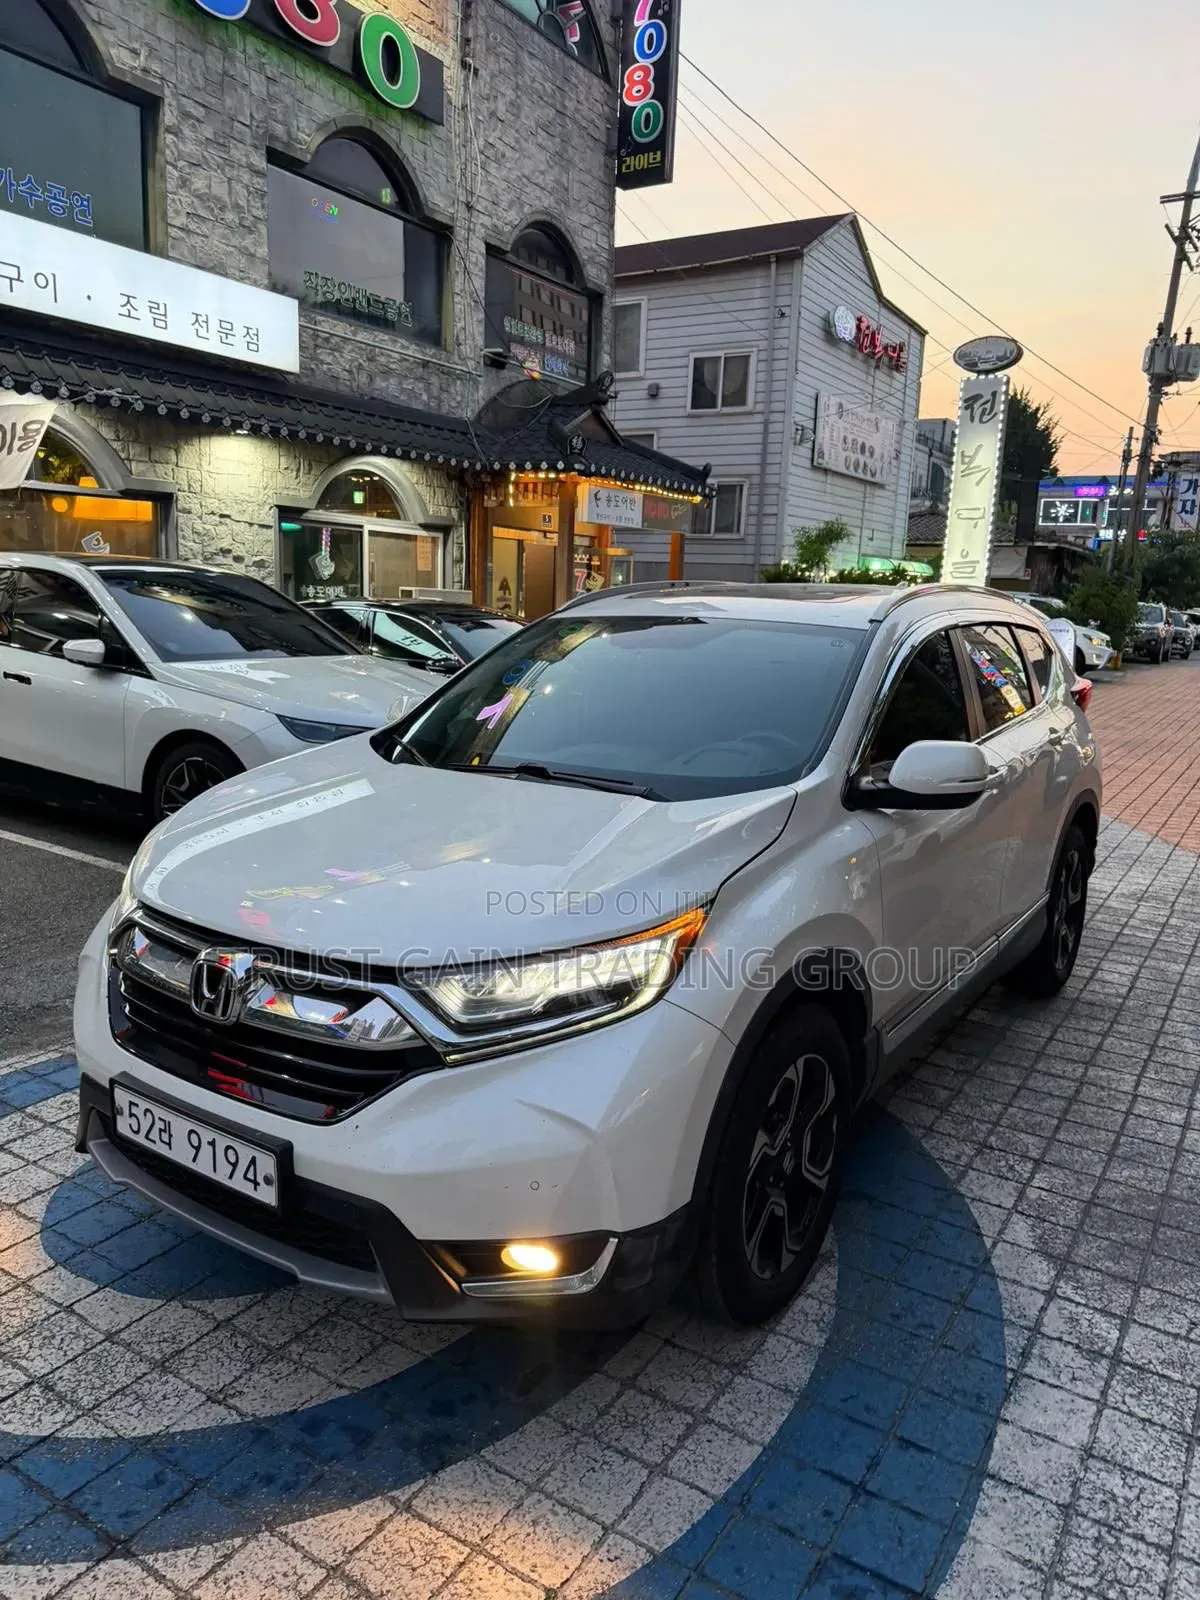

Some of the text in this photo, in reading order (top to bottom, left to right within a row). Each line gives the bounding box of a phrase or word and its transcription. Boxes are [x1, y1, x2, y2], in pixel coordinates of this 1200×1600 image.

[193, 0, 421, 108] 80
[622, 150, 662, 173] 라이브
[118, 292, 169, 331] 조림
[191, 310, 261, 353] 전문점
[127, 1100, 261, 1192] 52라 9194
